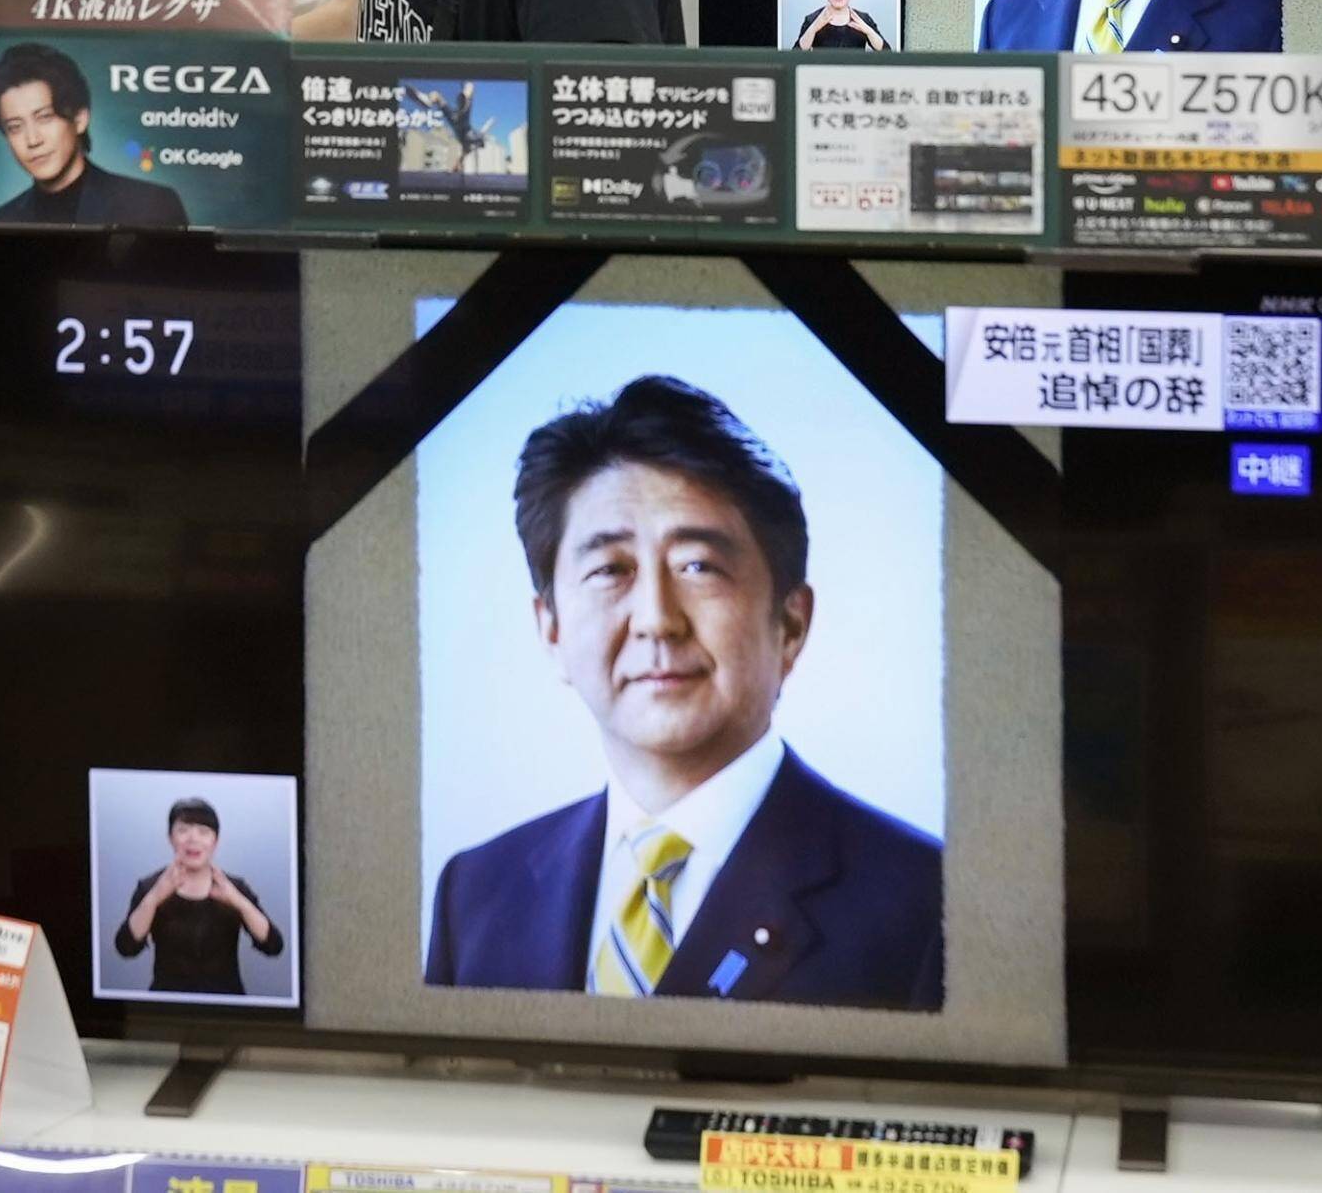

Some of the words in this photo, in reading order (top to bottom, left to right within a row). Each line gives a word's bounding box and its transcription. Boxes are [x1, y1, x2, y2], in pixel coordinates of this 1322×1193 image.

[110, 65, 272, 94] REGZA
[303, 108, 443, 129] くっきりなめらかに
[553, 108, 707, 129] つつみ込むサウンド
[808, 111, 909, 131] すぐ見つかる
[159, 149, 184, 166] OK
[186, 149, 243, 170] Google
[602, 180, 644, 198] Dolby
[1144, 197, 1186, 213] hulu
[56, 318, 194, 375] 2:57
[983, 323, 1204, 368] 安倍元首相「国葬」
[1039, 373, 1206, 414] 追悼の辞
[1237, 453, 1304, 487] 中継
[344, 1172, 414, 1189] TOSHIBA
[741, 1171, 836, 1191] TOSHIBA
